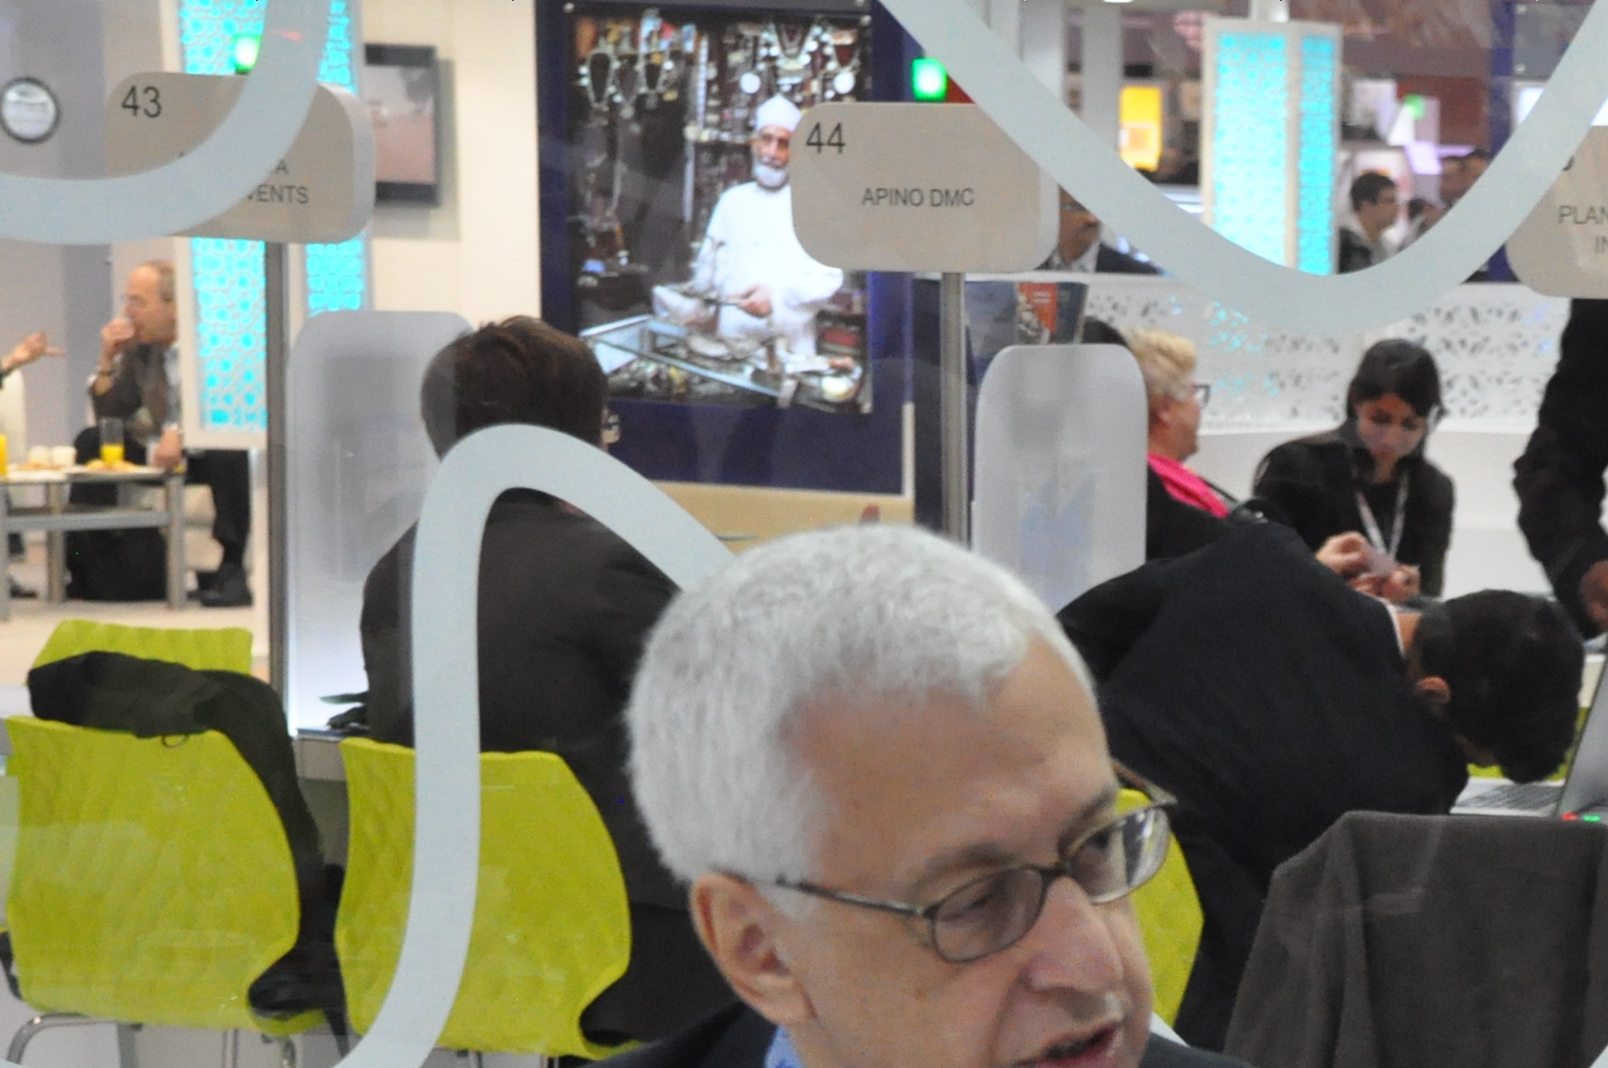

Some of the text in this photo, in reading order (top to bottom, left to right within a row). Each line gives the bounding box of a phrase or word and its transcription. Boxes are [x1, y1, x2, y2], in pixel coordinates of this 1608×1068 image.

[121, 86, 162, 118] 43
[806, 122, 846, 154] 44
[248, 184, 310, 204] ENTS
[861, 187, 975, 207] APINO DMC
